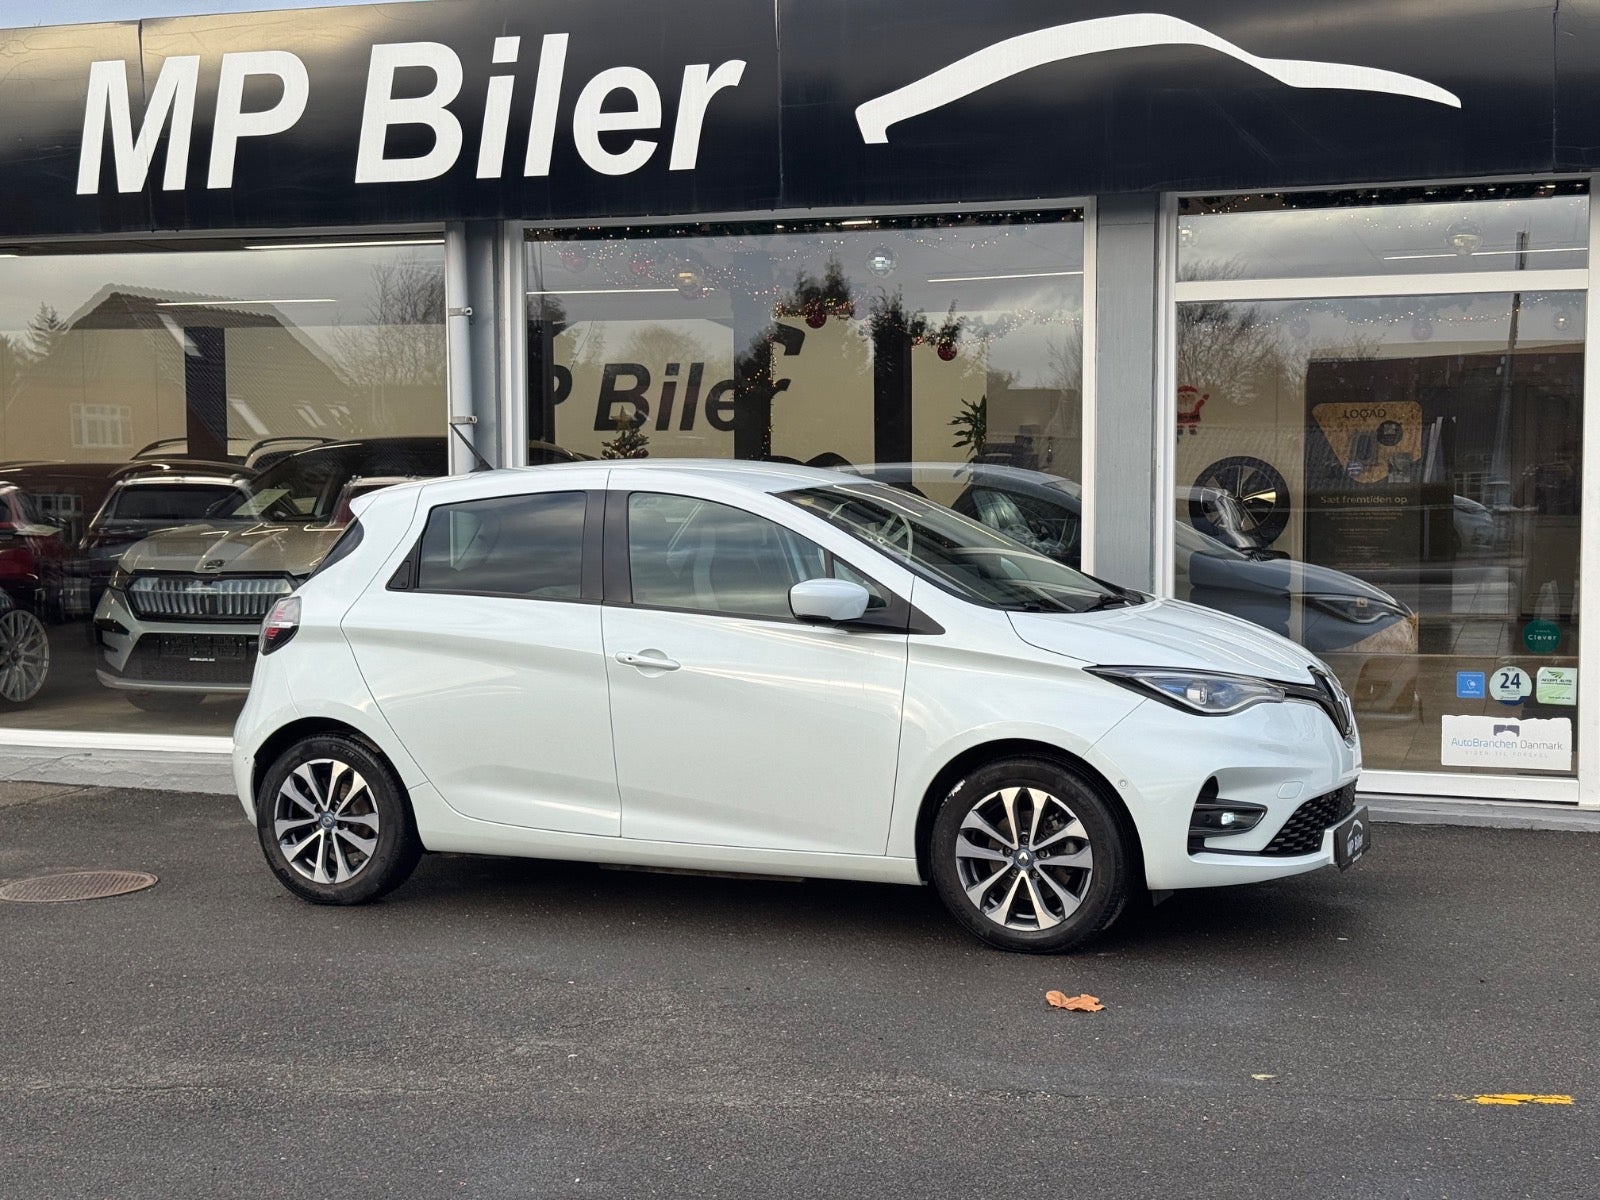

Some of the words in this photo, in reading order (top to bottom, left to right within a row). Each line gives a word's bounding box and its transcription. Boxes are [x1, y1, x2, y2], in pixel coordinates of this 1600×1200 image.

[75, 50, 310, 195] MP
[355, 32, 747, 185] Biler
[1342, 495, 1392, 504] fremtiden
[1394, 496, 1408, 505] op
[1499, 672, 1521, 689] 24
[1451, 737, 1517, 749] AutoBranchen
[1520, 739, 1563, 751] Danmark
